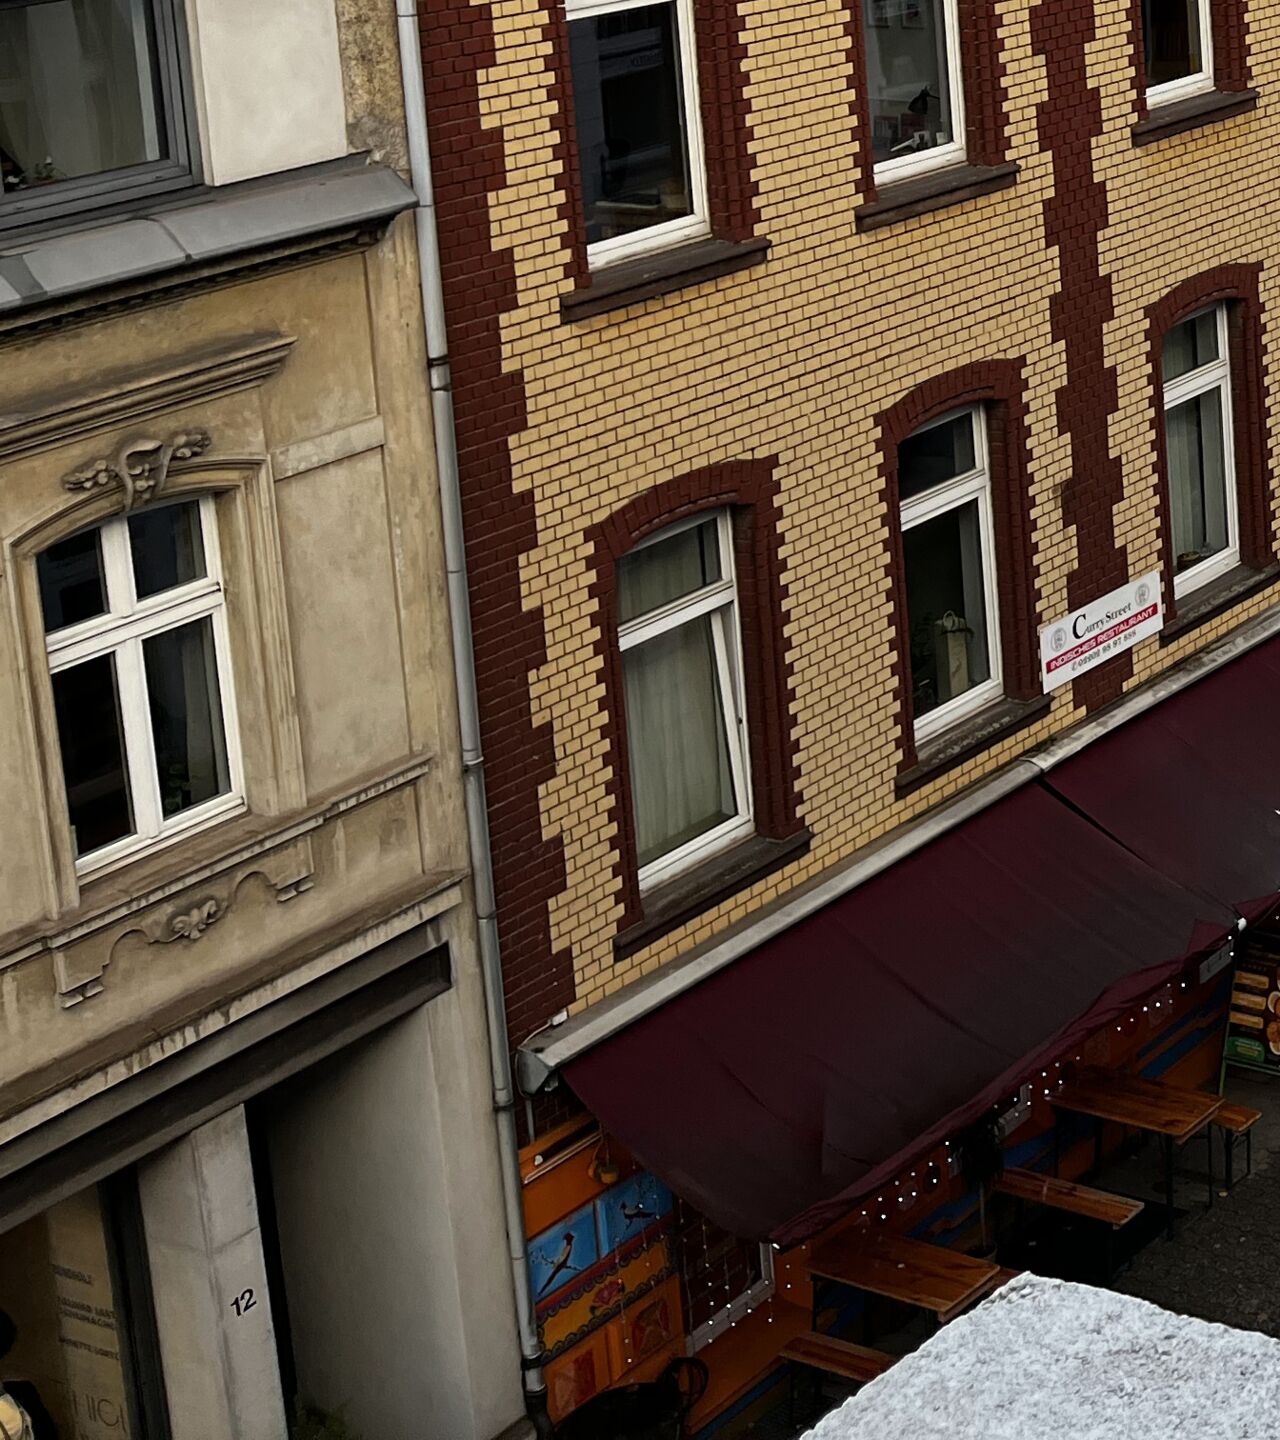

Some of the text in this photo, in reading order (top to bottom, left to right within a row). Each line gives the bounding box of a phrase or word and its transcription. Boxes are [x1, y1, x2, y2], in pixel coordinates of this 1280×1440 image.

[1050, 607, 1154, 670] INDISCHES RESTAURANT
[230, 1289, 257, 1317] 12
